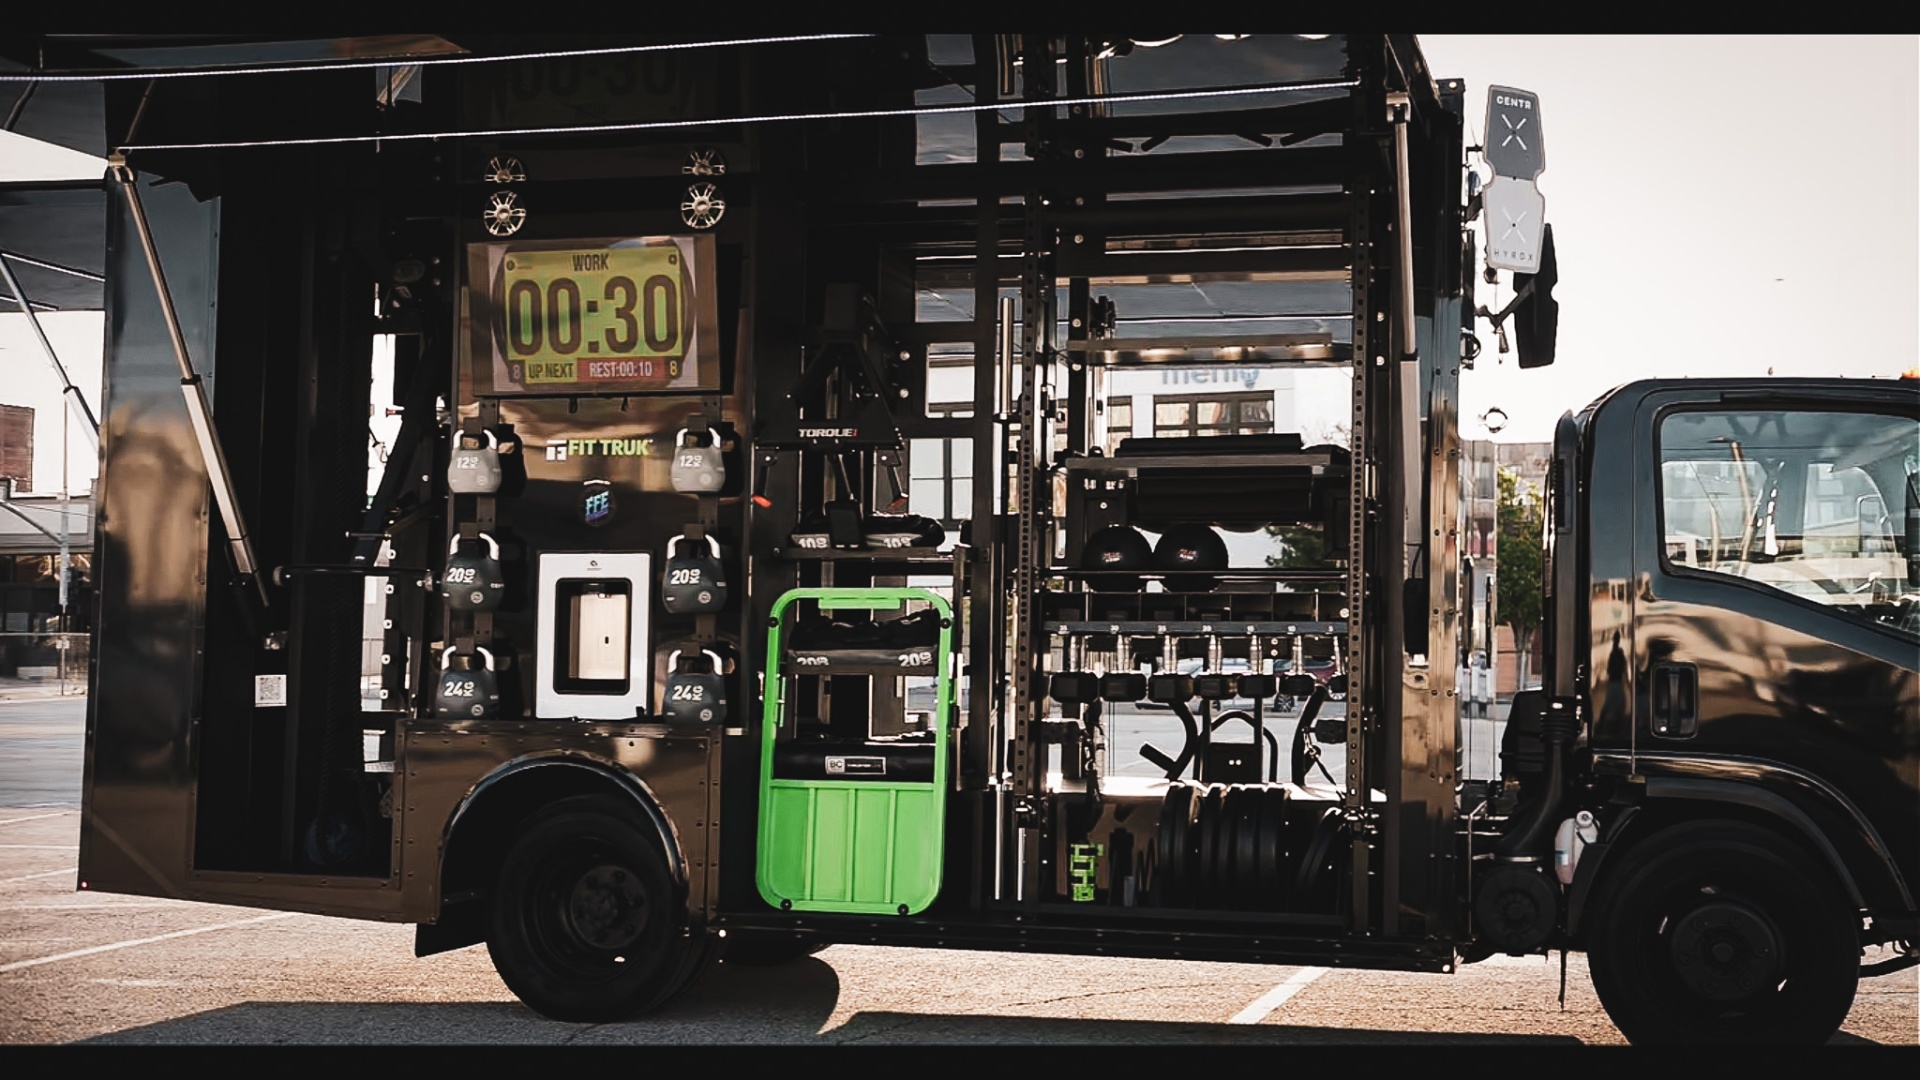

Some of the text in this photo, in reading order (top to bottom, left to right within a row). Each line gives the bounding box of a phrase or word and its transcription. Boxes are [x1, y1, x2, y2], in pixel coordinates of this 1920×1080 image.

[1496, 95, 1532, 110] CENTR
[572, 253, 609, 272] WORK
[1494, 249, 1533, 261] HYROX
[509, 275, 679, 355] 00:30
[528, 362, 574, 379] UP NEXT
[670, 360, 677, 375] 8
[568, 439, 649, 456] FIT TRUK
